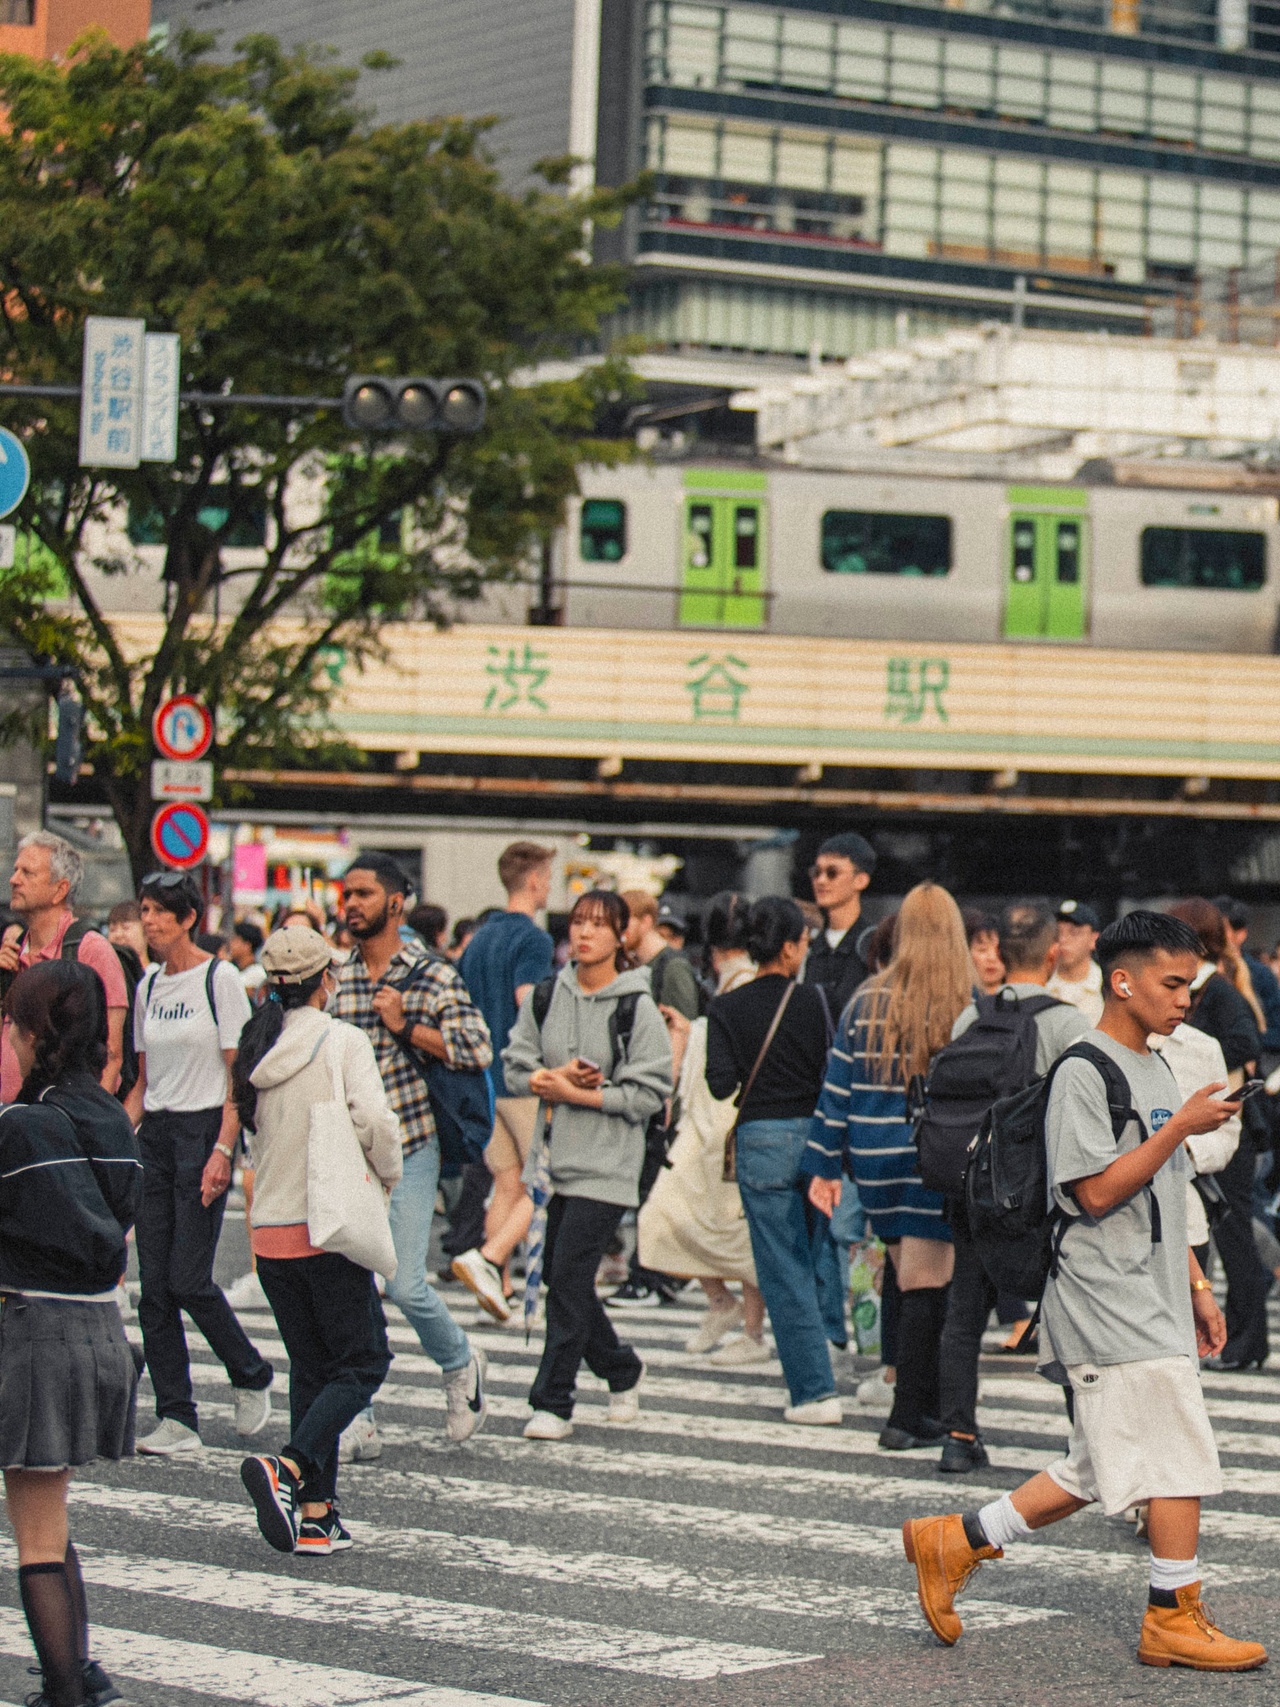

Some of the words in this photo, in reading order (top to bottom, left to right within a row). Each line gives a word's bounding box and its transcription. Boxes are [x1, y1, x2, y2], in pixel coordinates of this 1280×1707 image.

[107, 333, 133, 453] 渋谷駅前
[483, 643, 951, 724] 渋谷駅
